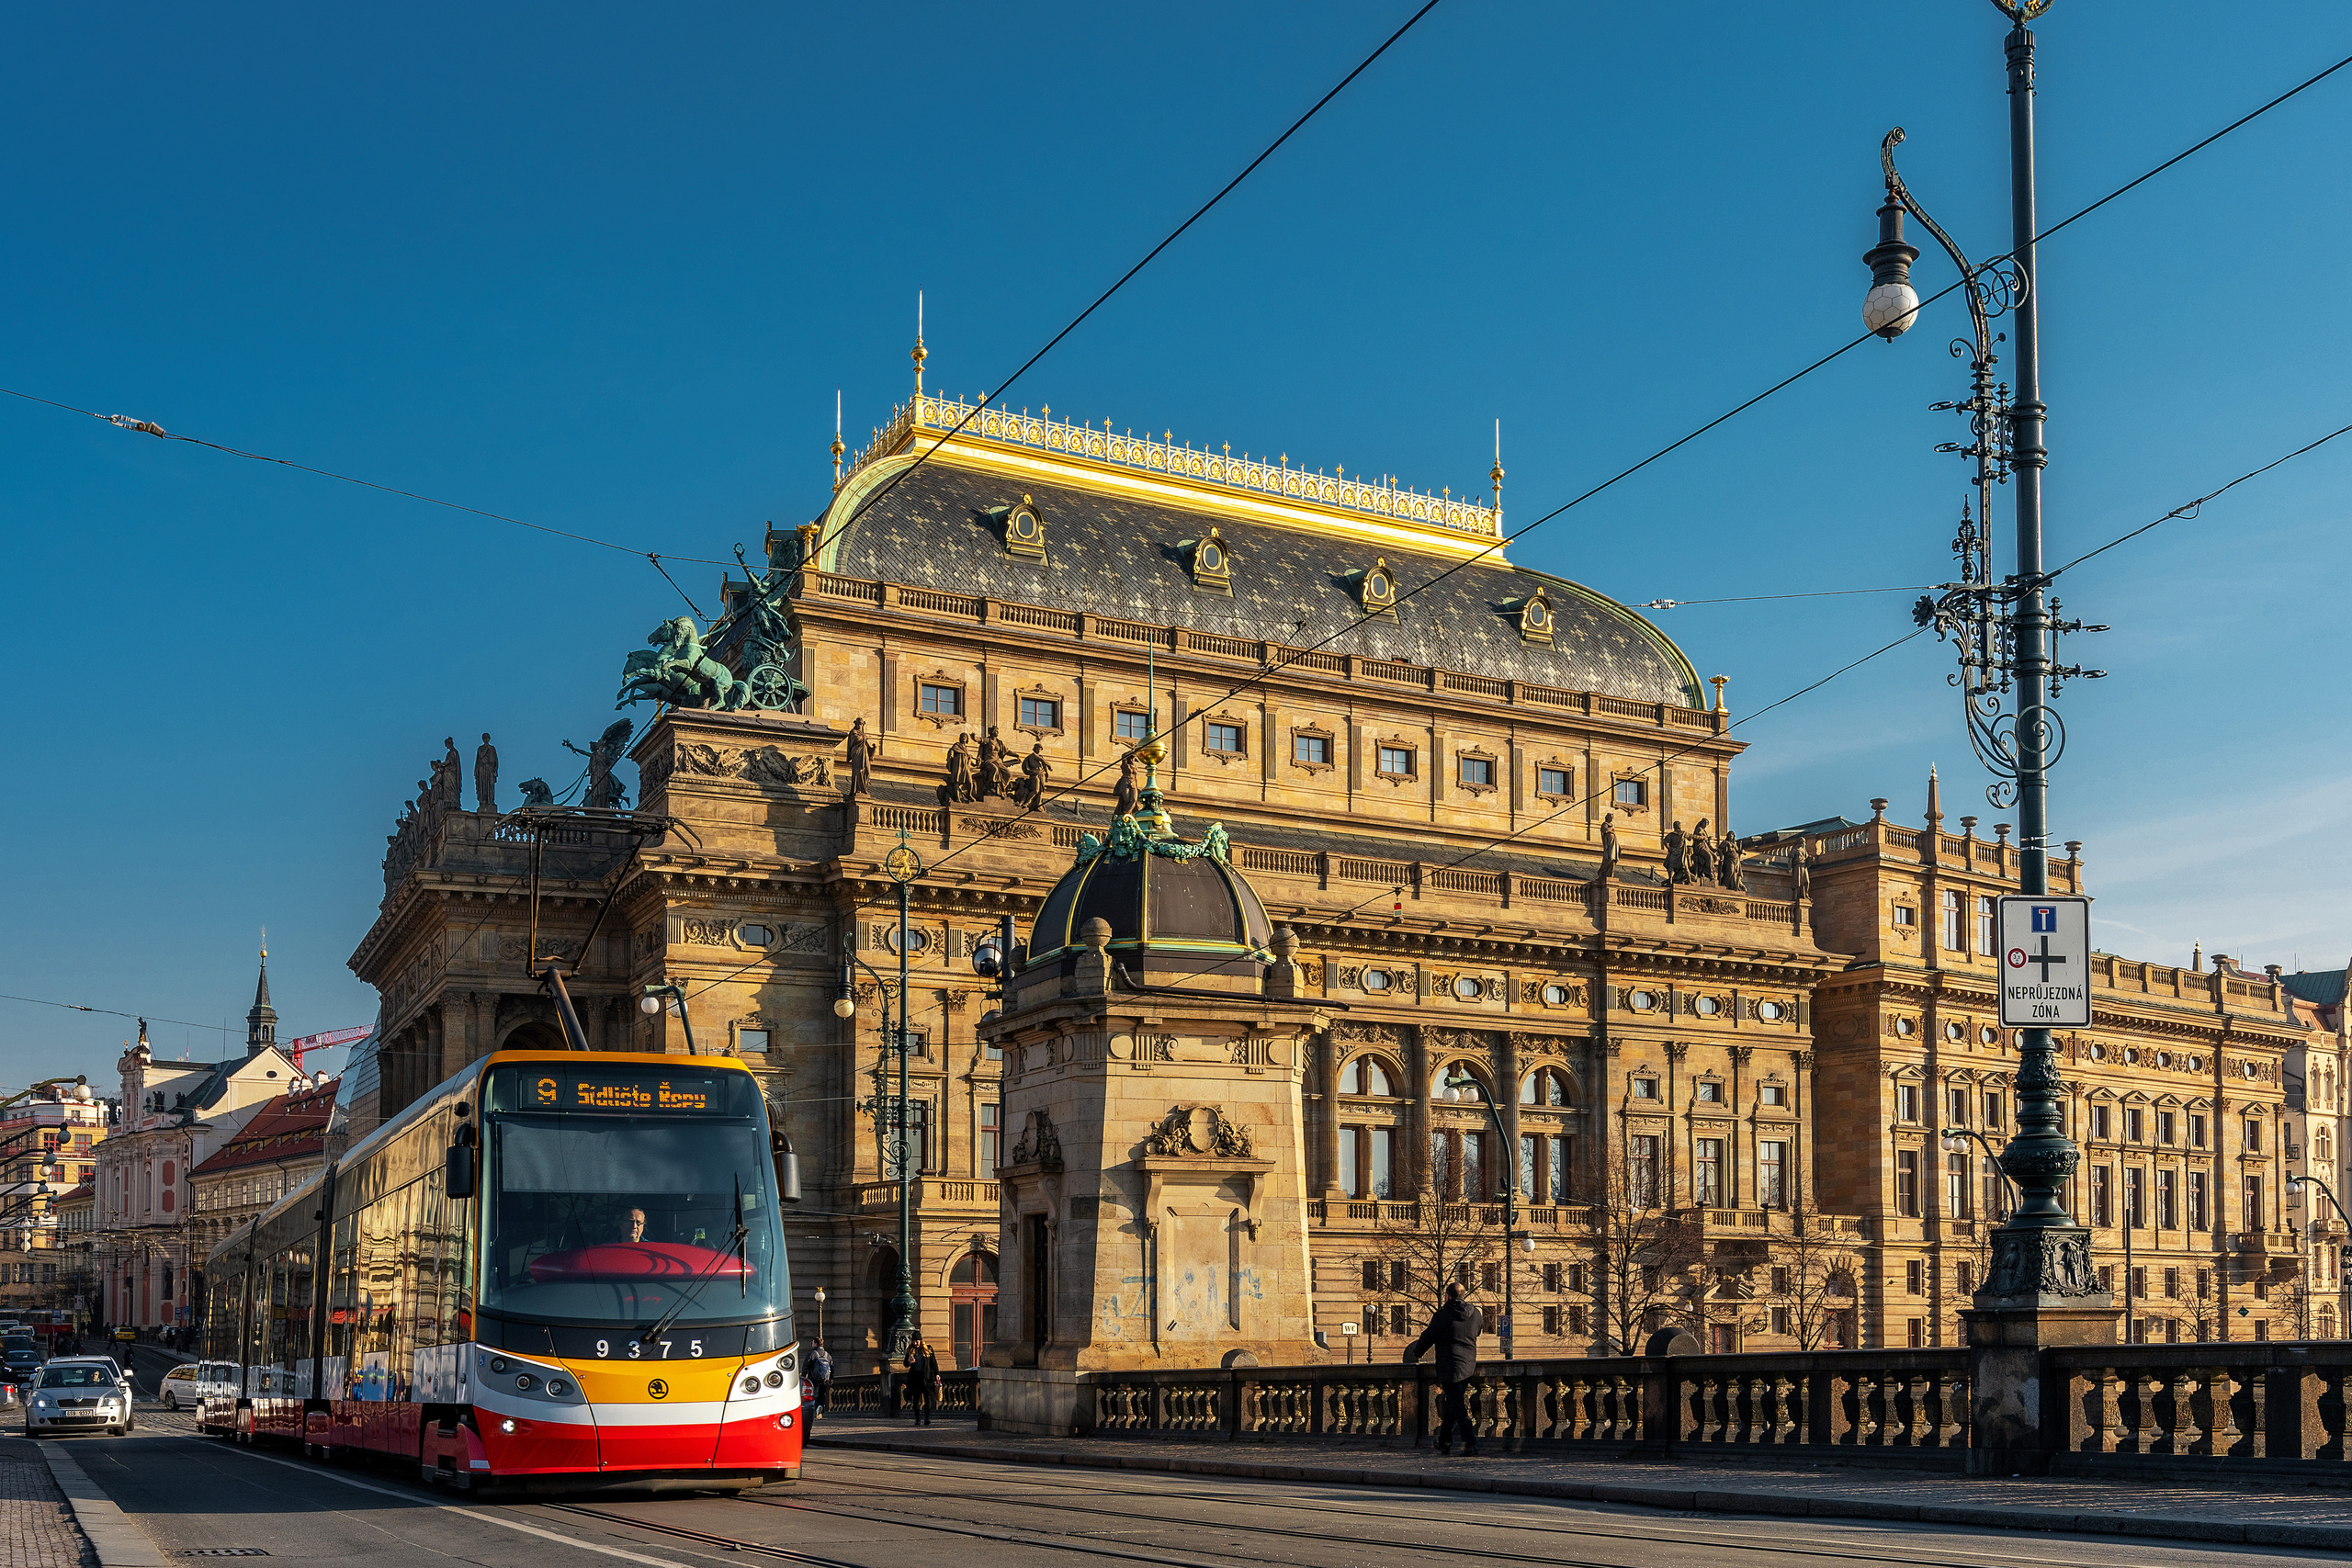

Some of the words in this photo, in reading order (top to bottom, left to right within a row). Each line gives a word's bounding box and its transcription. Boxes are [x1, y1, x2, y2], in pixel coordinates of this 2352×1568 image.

[2007, 983, 2083, 1000] NEPRŮJEZDNÁ
[2032, 1001, 2060, 1018] ZÓNA
[537, 1077, 557, 1105] 9
[596, 1339, 703, 1359] 9375
